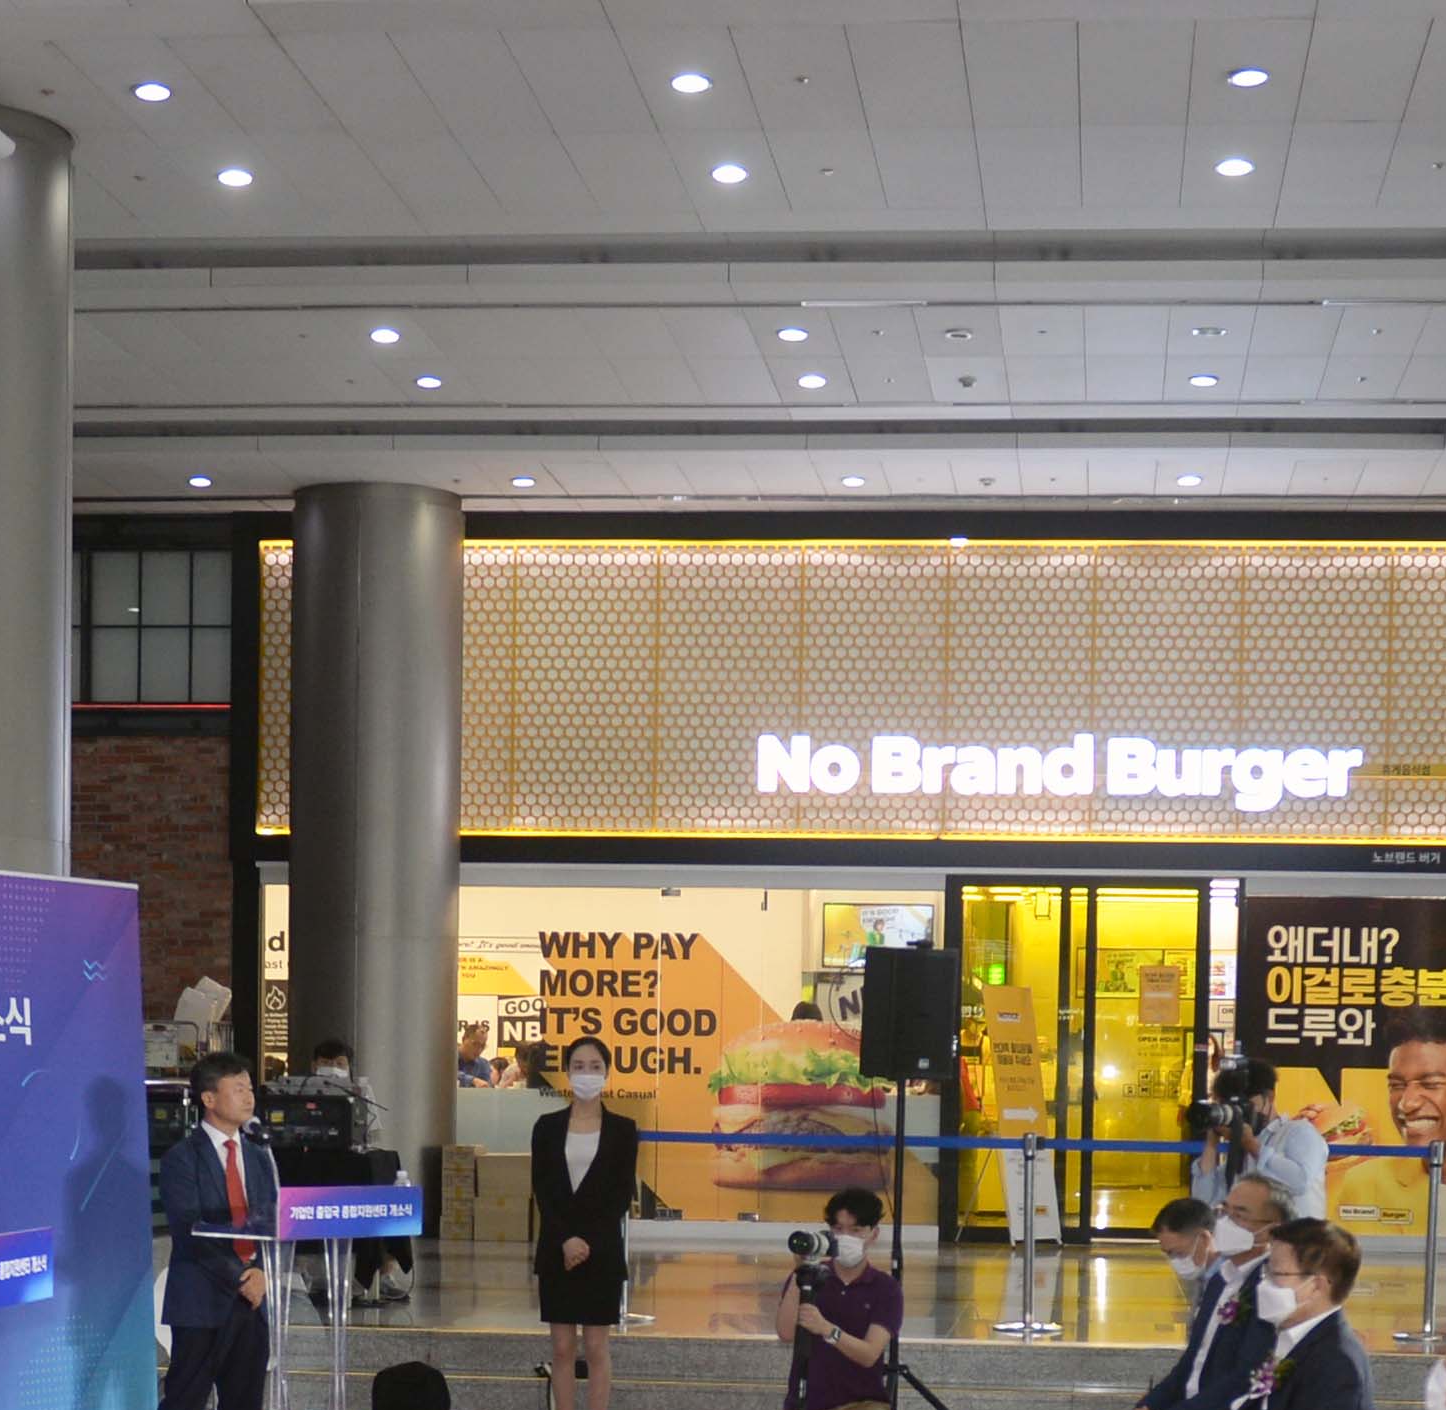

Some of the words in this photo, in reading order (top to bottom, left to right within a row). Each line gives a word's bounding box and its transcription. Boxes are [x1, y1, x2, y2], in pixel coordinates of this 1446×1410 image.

[757, 733, 861, 794] No
[870, 733, 1095, 795] Brand
[1105, 736, 1363, 812] Burger
[1372, 852, 1416, 864] 노브랜드
[1419, 851, 1441, 864] 버거
[539, 931, 620, 959] WHY
[633, 932, 699, 960] PAY
[540, 969, 660, 998] MORE?
[503, 1021, 542, 1042] NB
[613, 1008, 717, 1037] GOOD
[1265, 1007, 1376, 1046] 드루와
[540, 1045, 702, 1074] EUGH.
[617, 1088, 657, 1100] Casual
